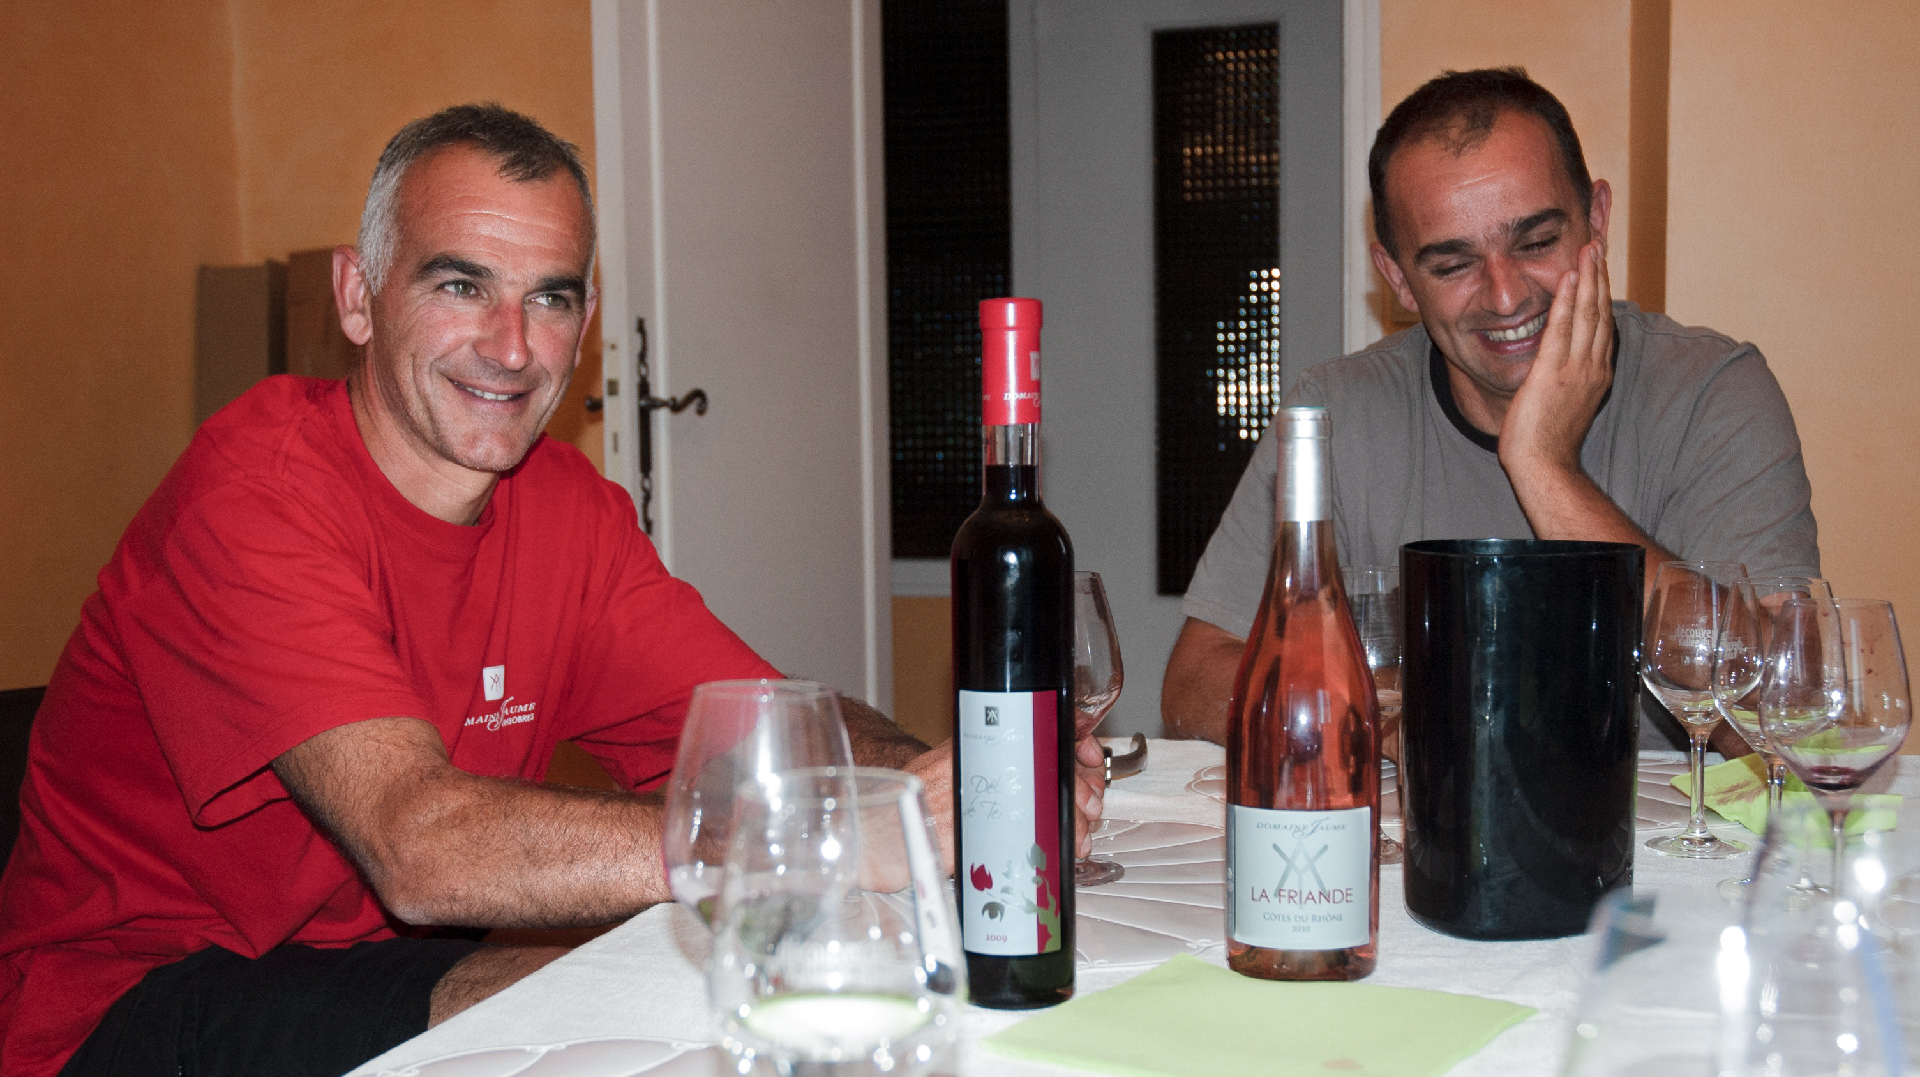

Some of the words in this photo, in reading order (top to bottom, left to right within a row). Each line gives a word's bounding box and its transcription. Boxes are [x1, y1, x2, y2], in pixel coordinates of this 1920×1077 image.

[501, 713, 535, 728] INSOBRES
[1256, 821, 1310, 832] DOMAINE
[1251, 886, 1270, 903] LA
[1278, 887, 1354, 905] FRIANDE
